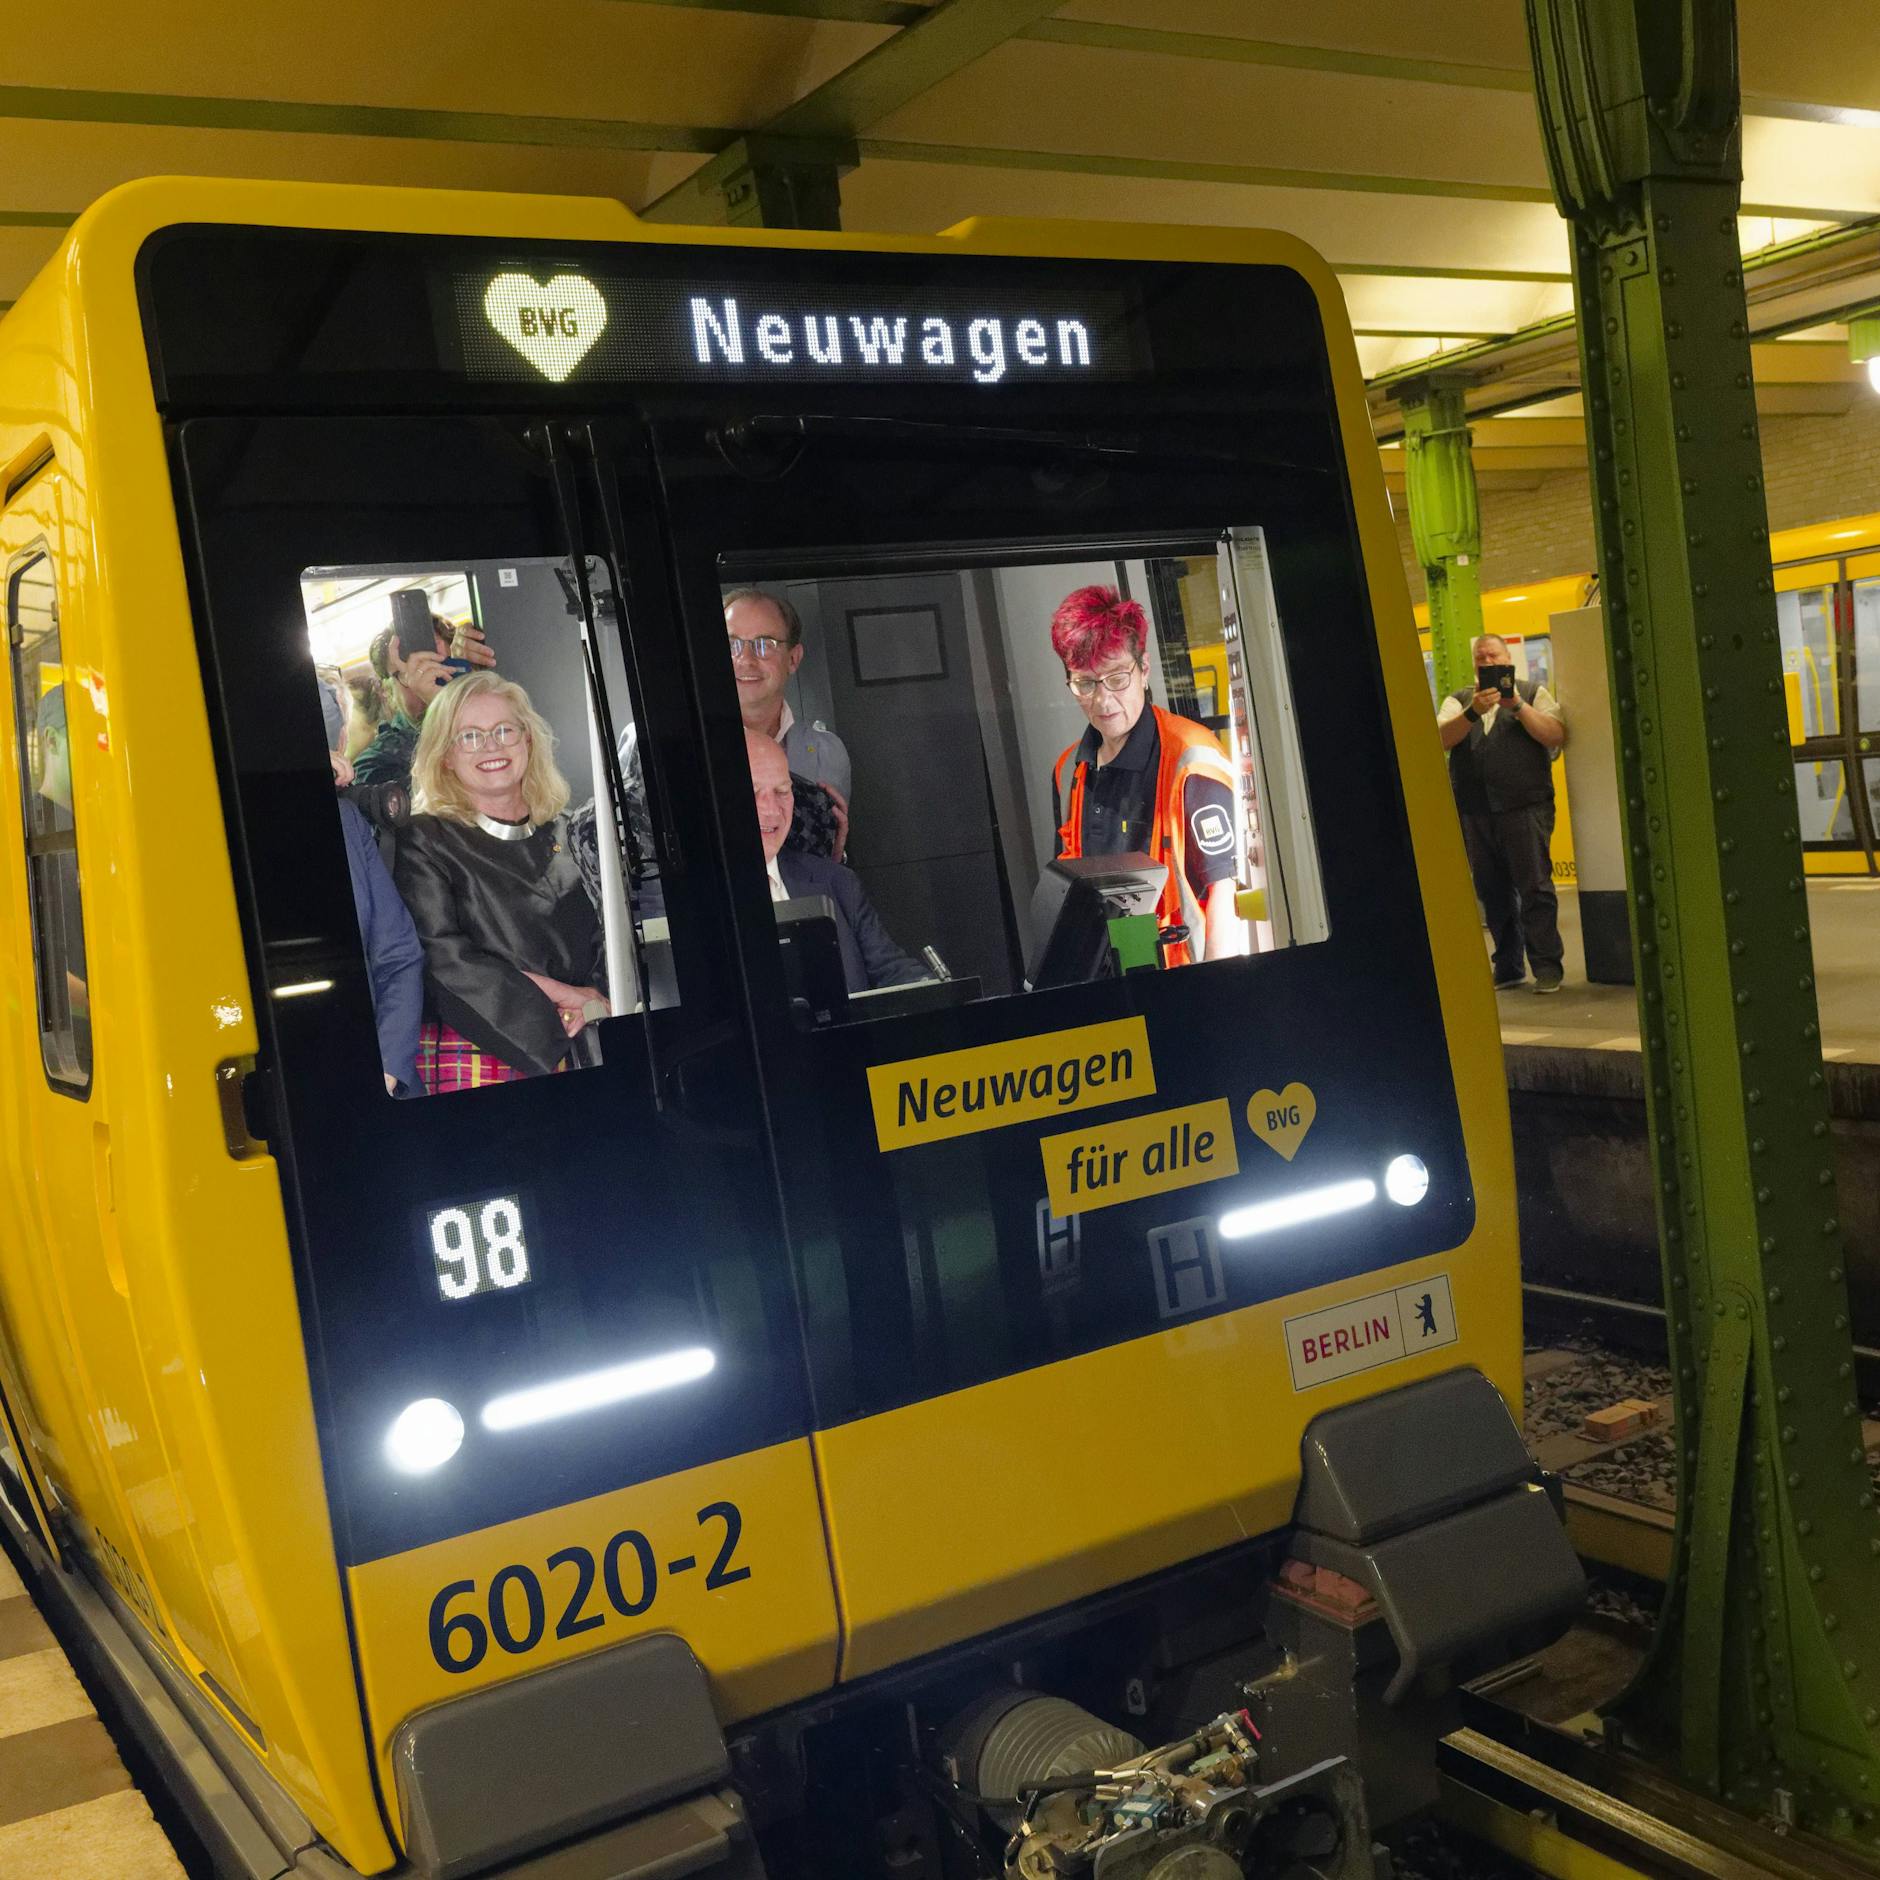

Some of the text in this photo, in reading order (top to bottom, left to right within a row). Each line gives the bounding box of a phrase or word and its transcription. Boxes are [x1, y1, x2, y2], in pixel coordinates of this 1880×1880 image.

[519, 307, 578, 337] BVG
[691, 298, 1090, 383] Neuwagen
[898, 1048, 1132, 1127] Neuwagen
[1266, 1105, 1300, 1131] BVG
[1066, 1123, 1215, 1194] für alle
[430, 1199, 527, 1300] 98
[1302, 1316, 1390, 1364] BERLIN
[428, 1501, 751, 1674] 6020-2
